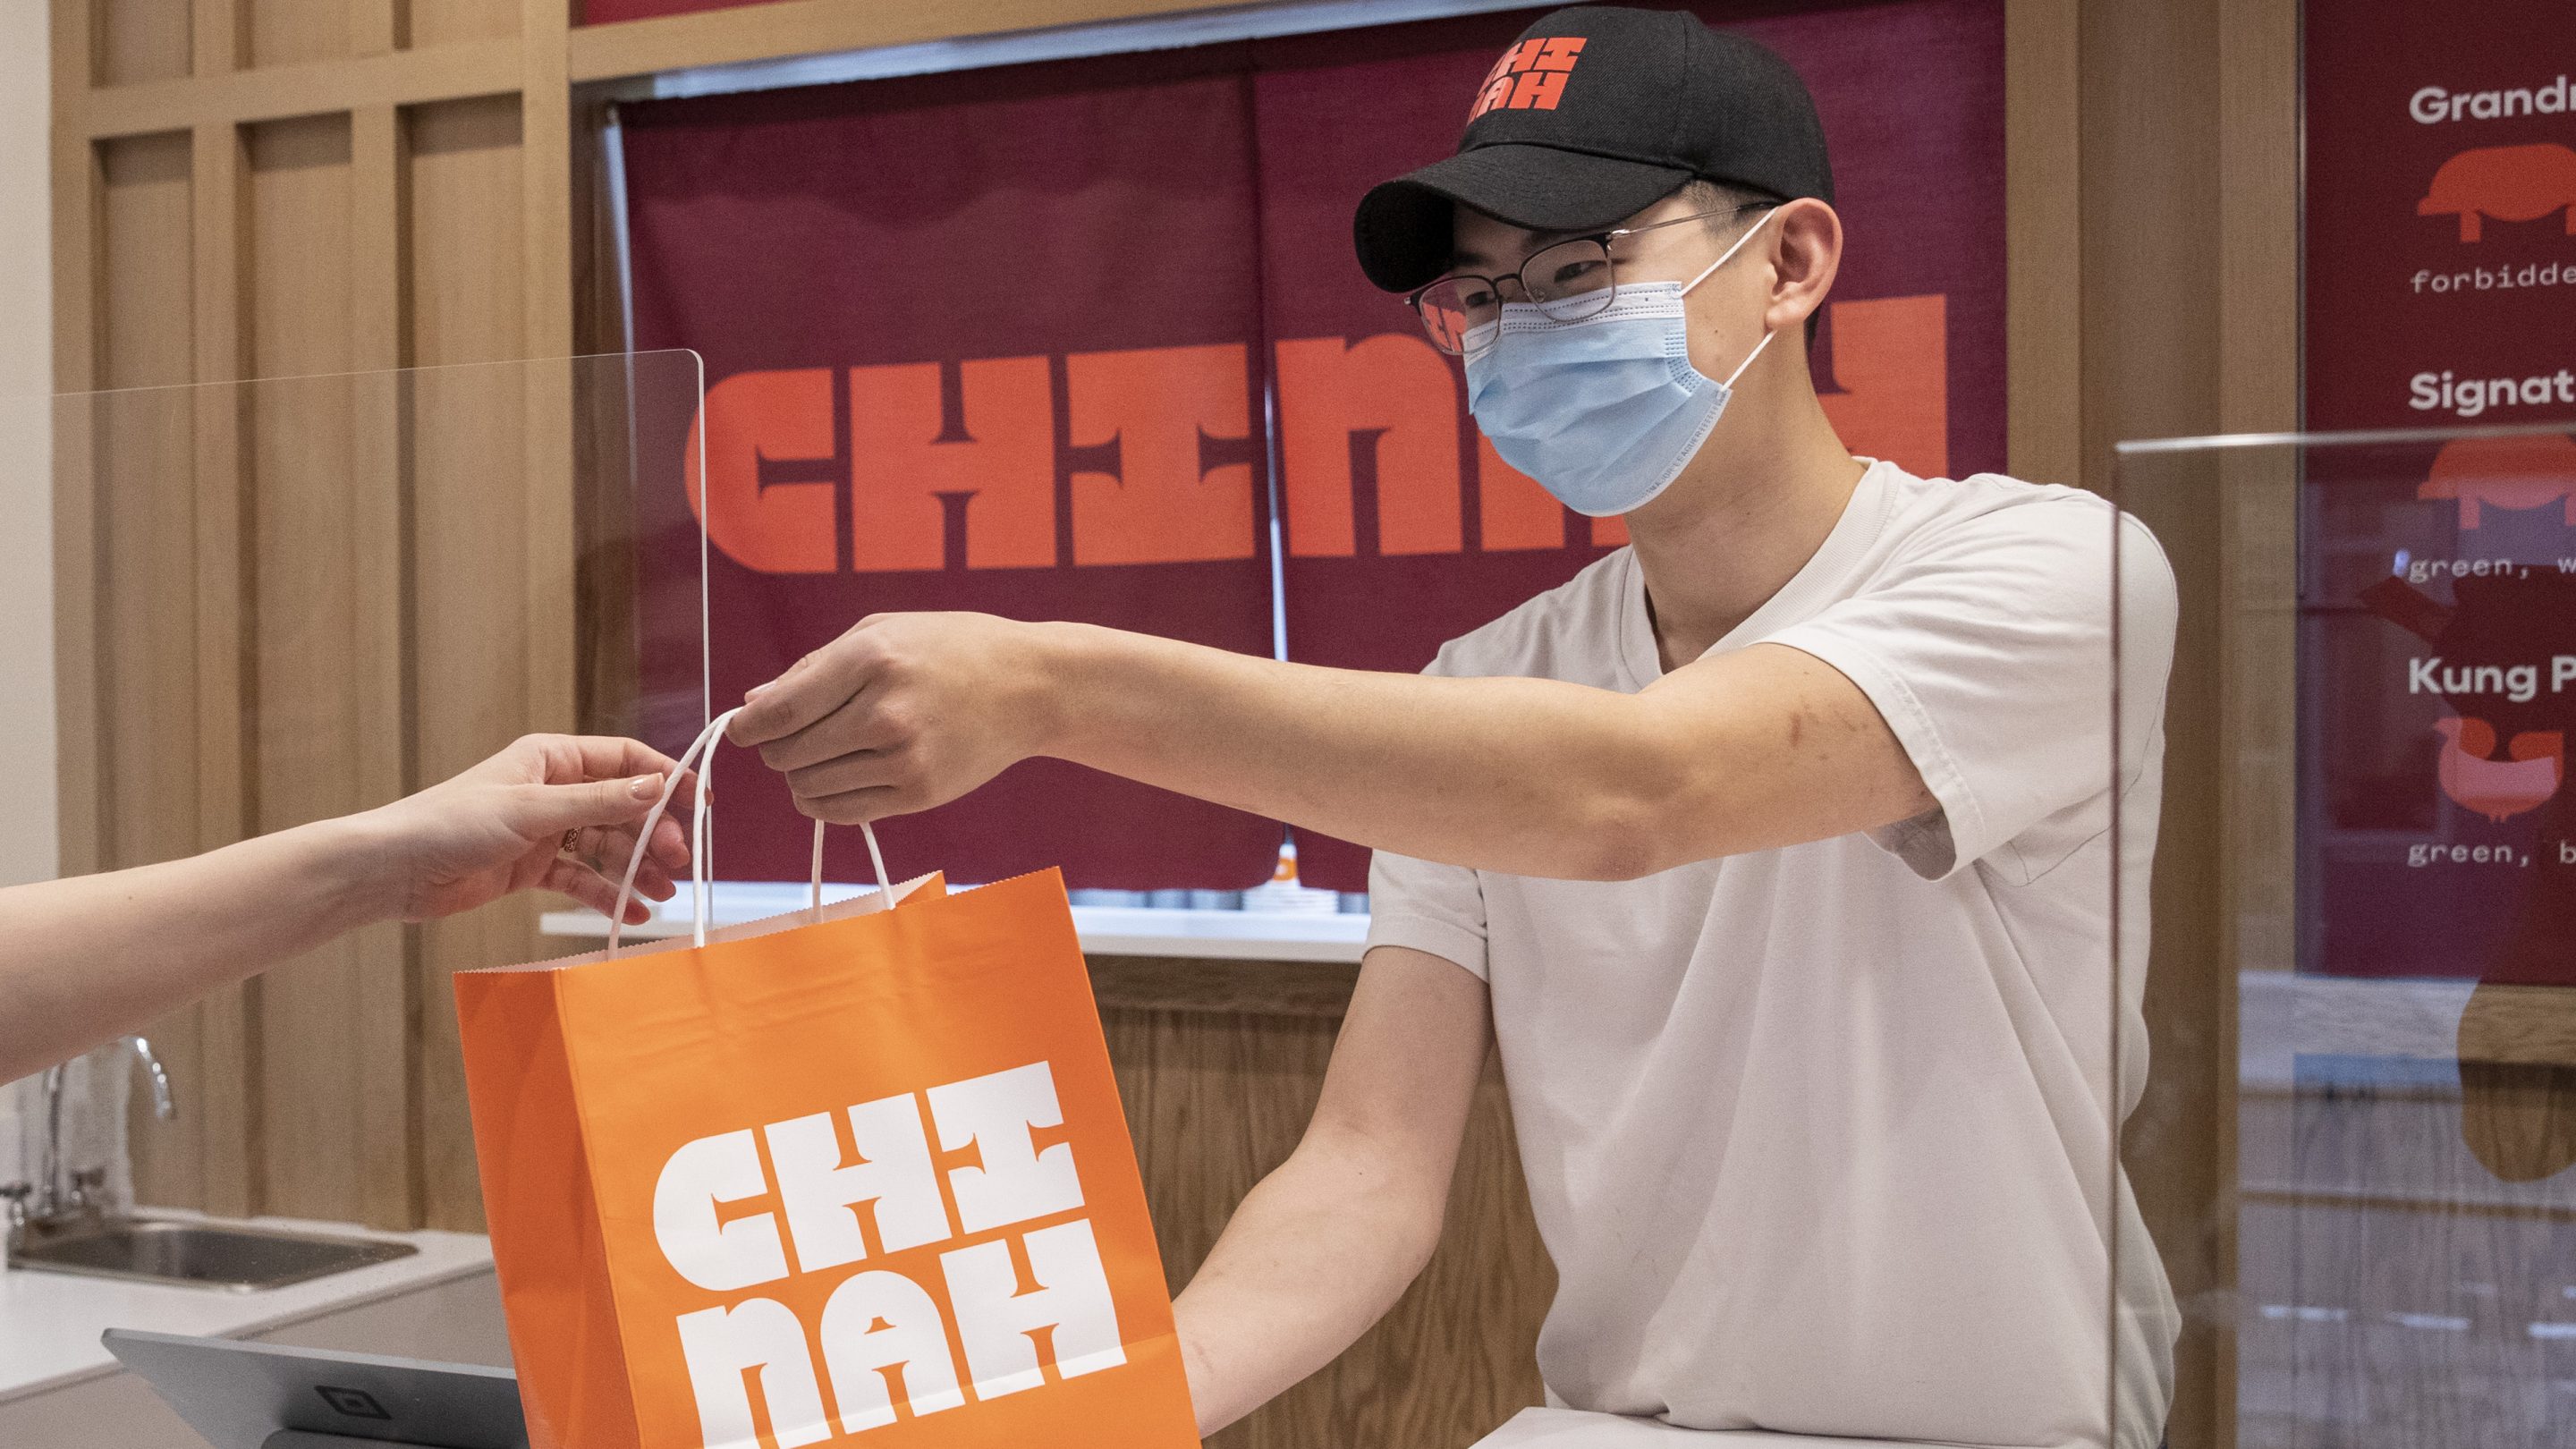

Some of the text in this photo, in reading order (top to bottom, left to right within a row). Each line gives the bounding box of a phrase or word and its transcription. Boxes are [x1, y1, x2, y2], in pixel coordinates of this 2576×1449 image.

[2411, 262, 2576, 293] forbidde
[2409, 369, 2576, 417] Signat
[2409, 558, 2529, 582] green,
[2409, 657, 2538, 703] Kung
[2407, 843, 2529, 868] green,
[653, 1060, 1085, 1292] CHI
